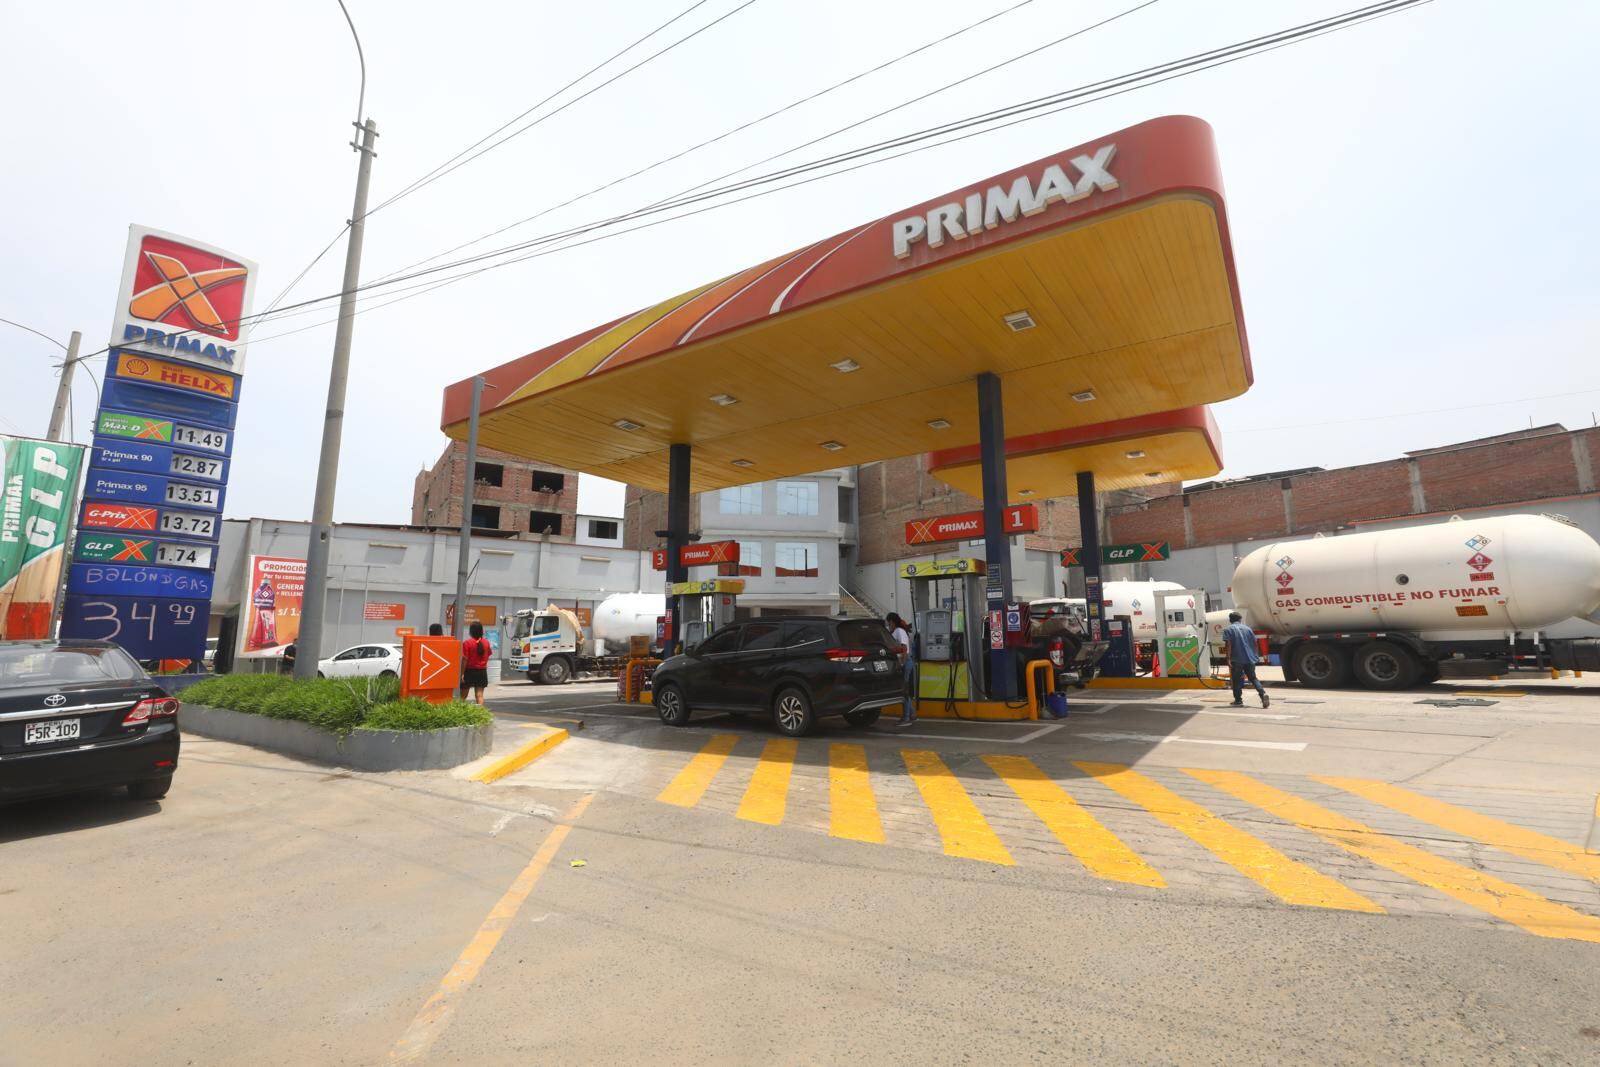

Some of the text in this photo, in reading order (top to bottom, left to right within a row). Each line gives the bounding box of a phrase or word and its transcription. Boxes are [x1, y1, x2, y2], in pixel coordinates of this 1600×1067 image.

[892, 143, 1120, 260] PRIMAX
[124, 324, 236, 365] PRIMAX
[161, 369, 228, 394] HELIX
[176, 428, 223, 448] 11.49
[102, 449, 218, 476] Primax 90 12.87
[25, 446, 69, 548] GLP
[96, 480, 213, 504] Primax 95 13.51
[2, 474, 24, 543] PRIMAX
[88, 509, 211, 533] G-Prix 13.72
[938, 520, 978, 533] PRIMAX
[1011, 510, 1024, 528] 1
[84, 542, 197, 563] GLP 1.74
[656, 552, 664, 566] 3
[684, 550, 710, 560] PRIMAX
[1109, 549, 1135, 559] GLP
[174, 576, 208, 593] GAS
[276, 583, 304, 591] GENERA
[1275, 586, 1500, 608] GAS COMBUSTIBLE NO FUMAR
[169, 603, 196, 621] 99
[1166, 640, 1191, 648] GLP
[27, 723, 78, 741] F5R-109
